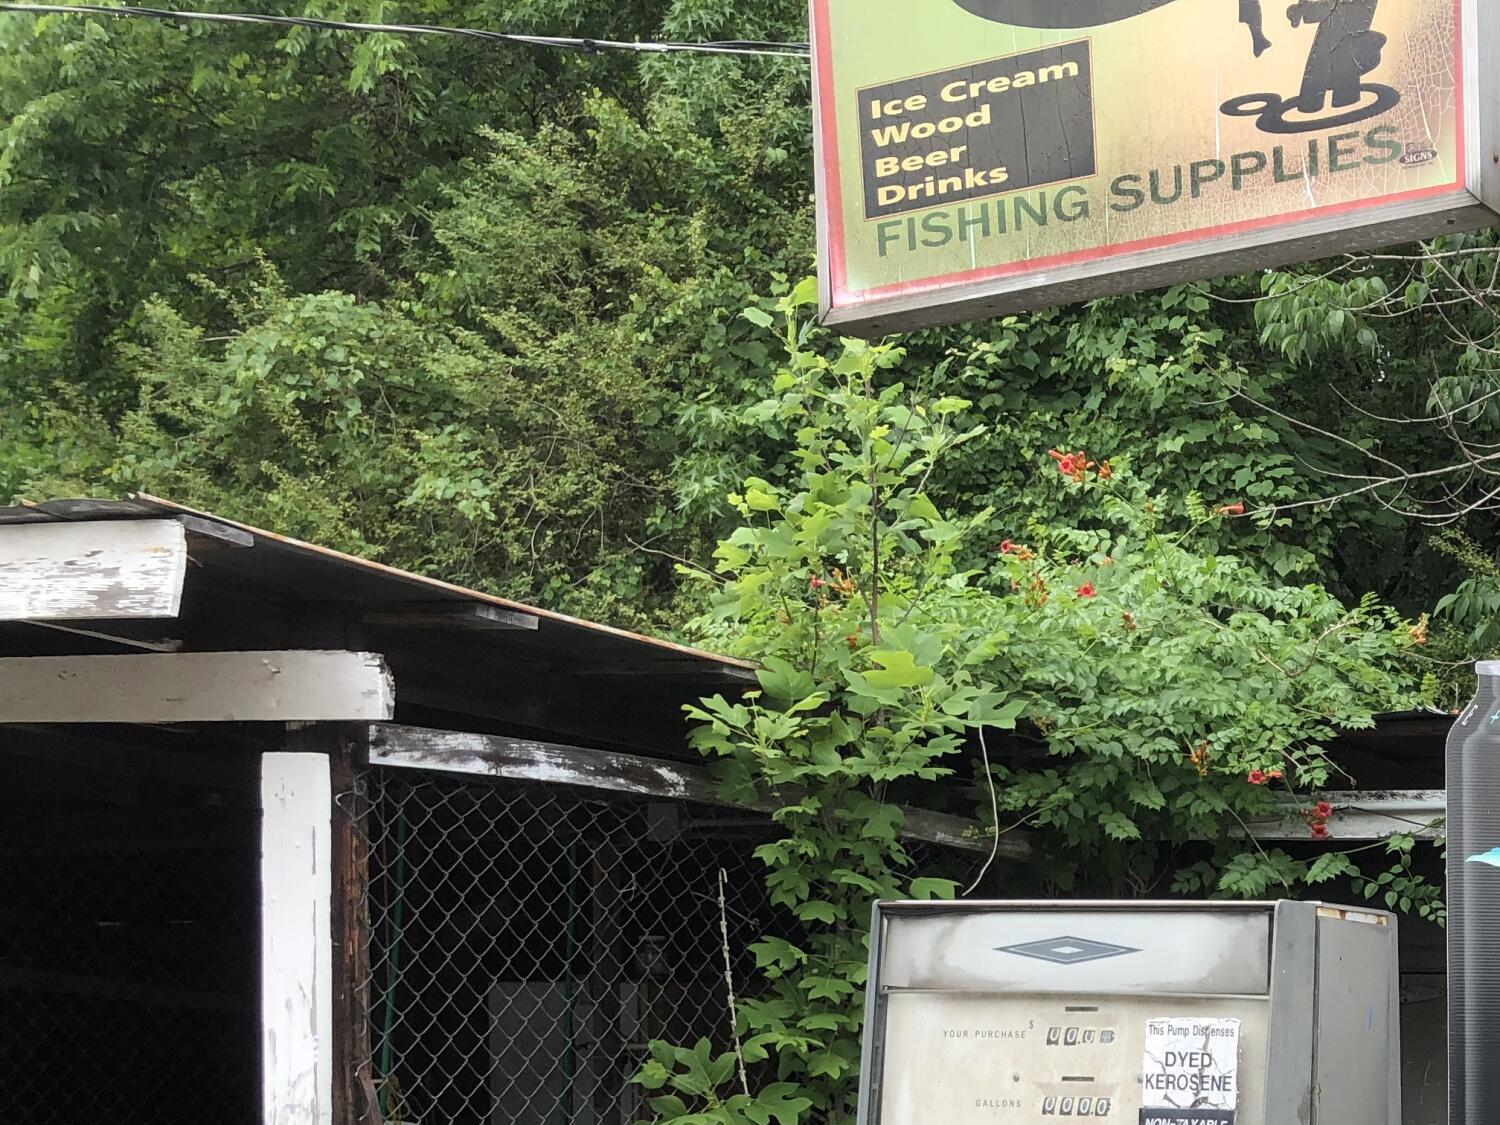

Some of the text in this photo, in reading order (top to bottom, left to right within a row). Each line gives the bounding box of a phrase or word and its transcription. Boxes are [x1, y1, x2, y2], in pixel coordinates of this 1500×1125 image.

[871, 61, 1079, 119] Ice Cream
[871, 104, 991, 147] Wood
[875, 145, 967, 178] Beer
[1404, 151, 1433, 164] SIGNS
[877, 166, 1009, 206] Drinks
[877, 124, 1402, 257] FISHING SUPPLIES
[943, 1030, 968, 1039] YOUR
[975, 1030, 1026, 1039] PURCHASE
[1148, 1024, 1164, 1036] This
[1167, 1024, 1189, 1039] Pump
[1165, 1051, 1213, 1068] DYED
[1145, 1073, 1233, 1092] KEROSENE
[975, 1099, 1022, 1108] GALLONS
